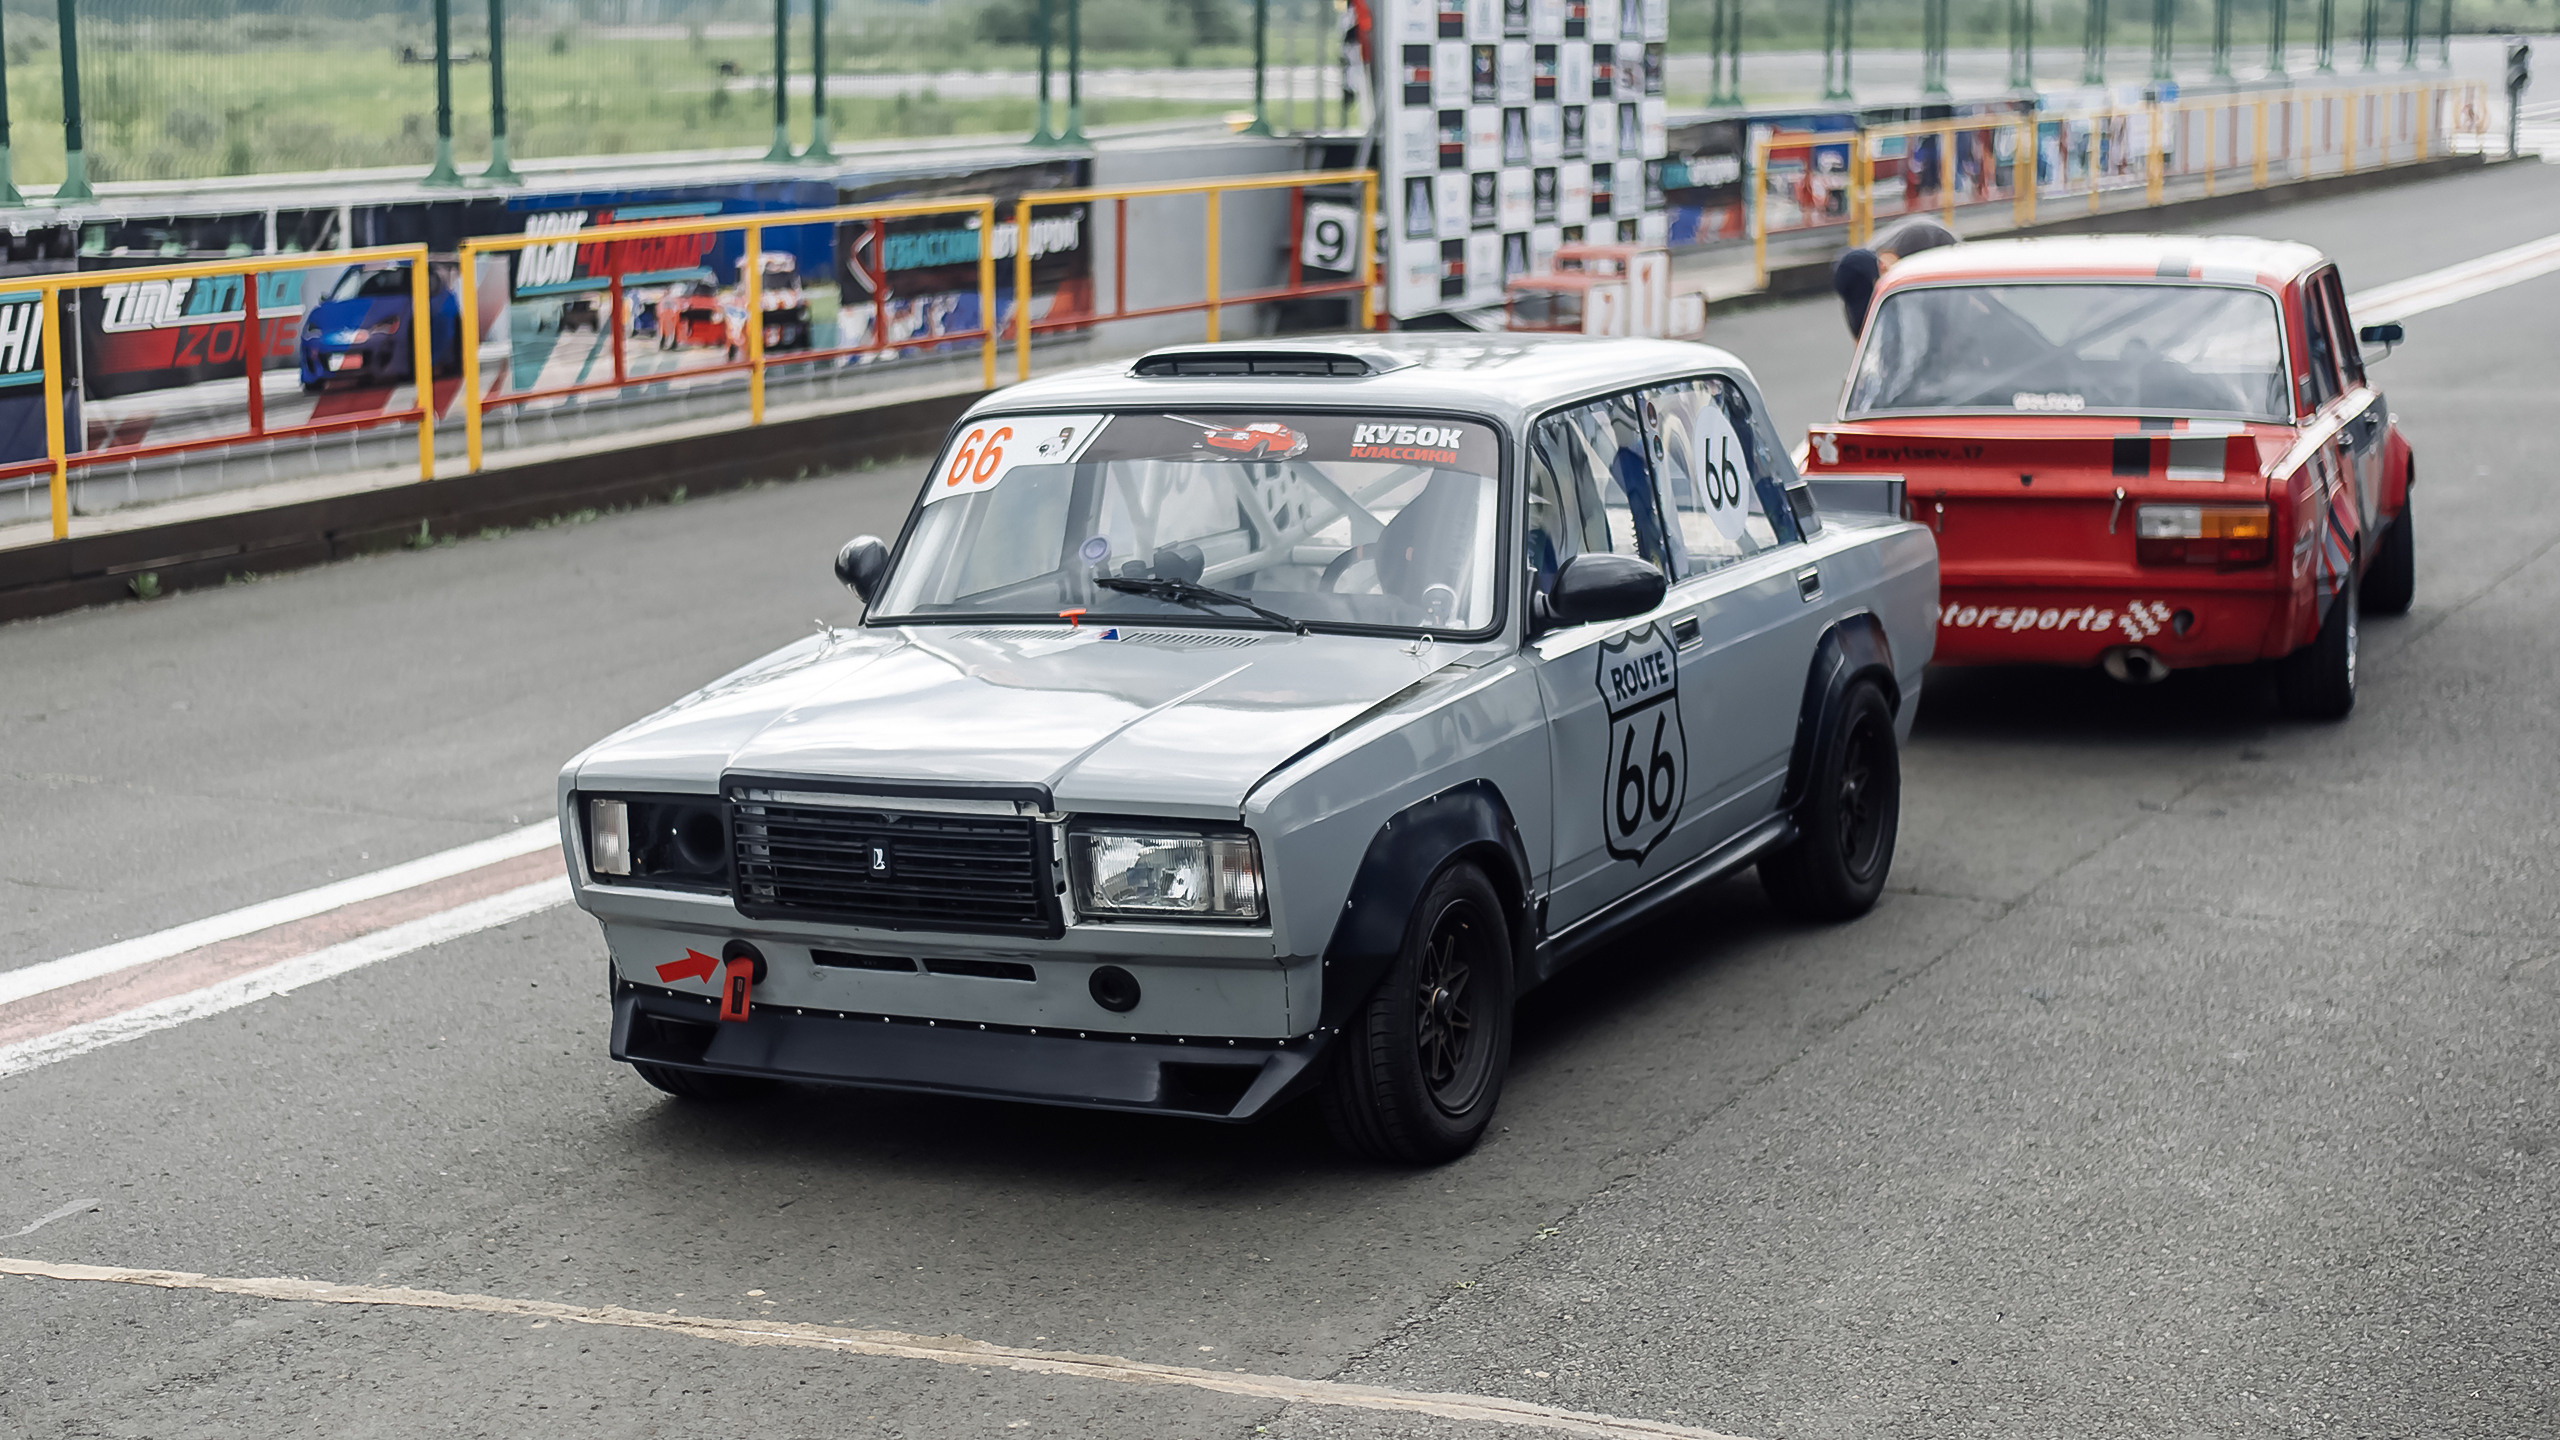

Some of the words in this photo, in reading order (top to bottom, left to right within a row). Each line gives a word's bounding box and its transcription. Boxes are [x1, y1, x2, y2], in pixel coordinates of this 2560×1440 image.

[1316, 220, 1345, 262] 9
[175, 315, 301, 367] ZONE
[947, 427, 1013, 487] 66
[1349, 446, 1457, 464] КЛАССИКИ
[1352, 423, 1463, 449] КУБОК
[1705, 436, 1741, 512] 66
[1937, 601, 2114, 633] torsports
[1610, 651, 1669, 702] ROUTE
[1616, 711, 1676, 837] 66
